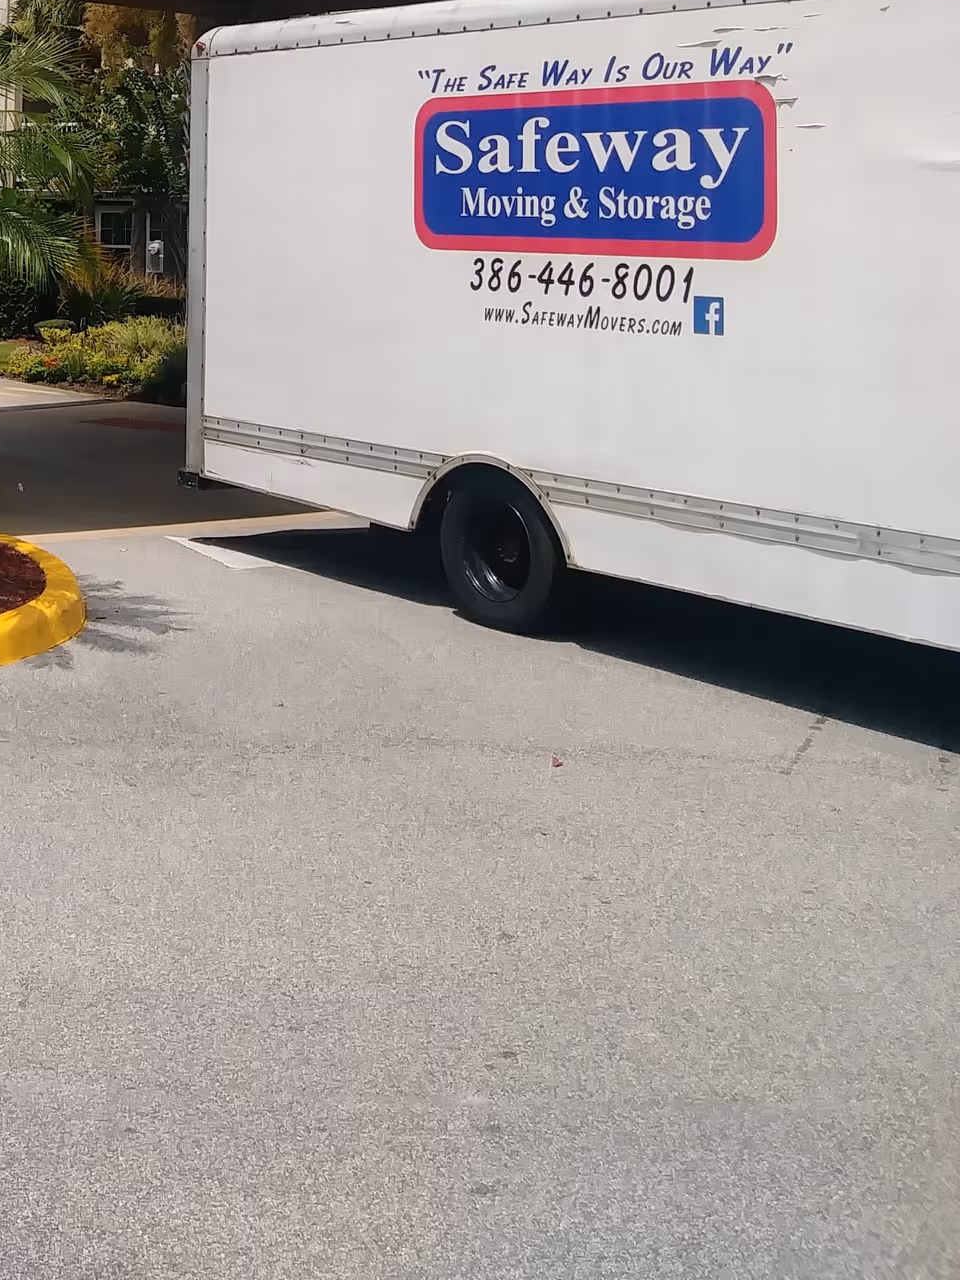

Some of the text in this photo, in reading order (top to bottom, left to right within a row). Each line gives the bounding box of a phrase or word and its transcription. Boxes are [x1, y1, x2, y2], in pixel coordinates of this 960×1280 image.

[435, 117, 749, 189] Safeway
[460, 186, 712, 230] Moving & Storage
[470, 258, 693, 304] 386-446-8001
